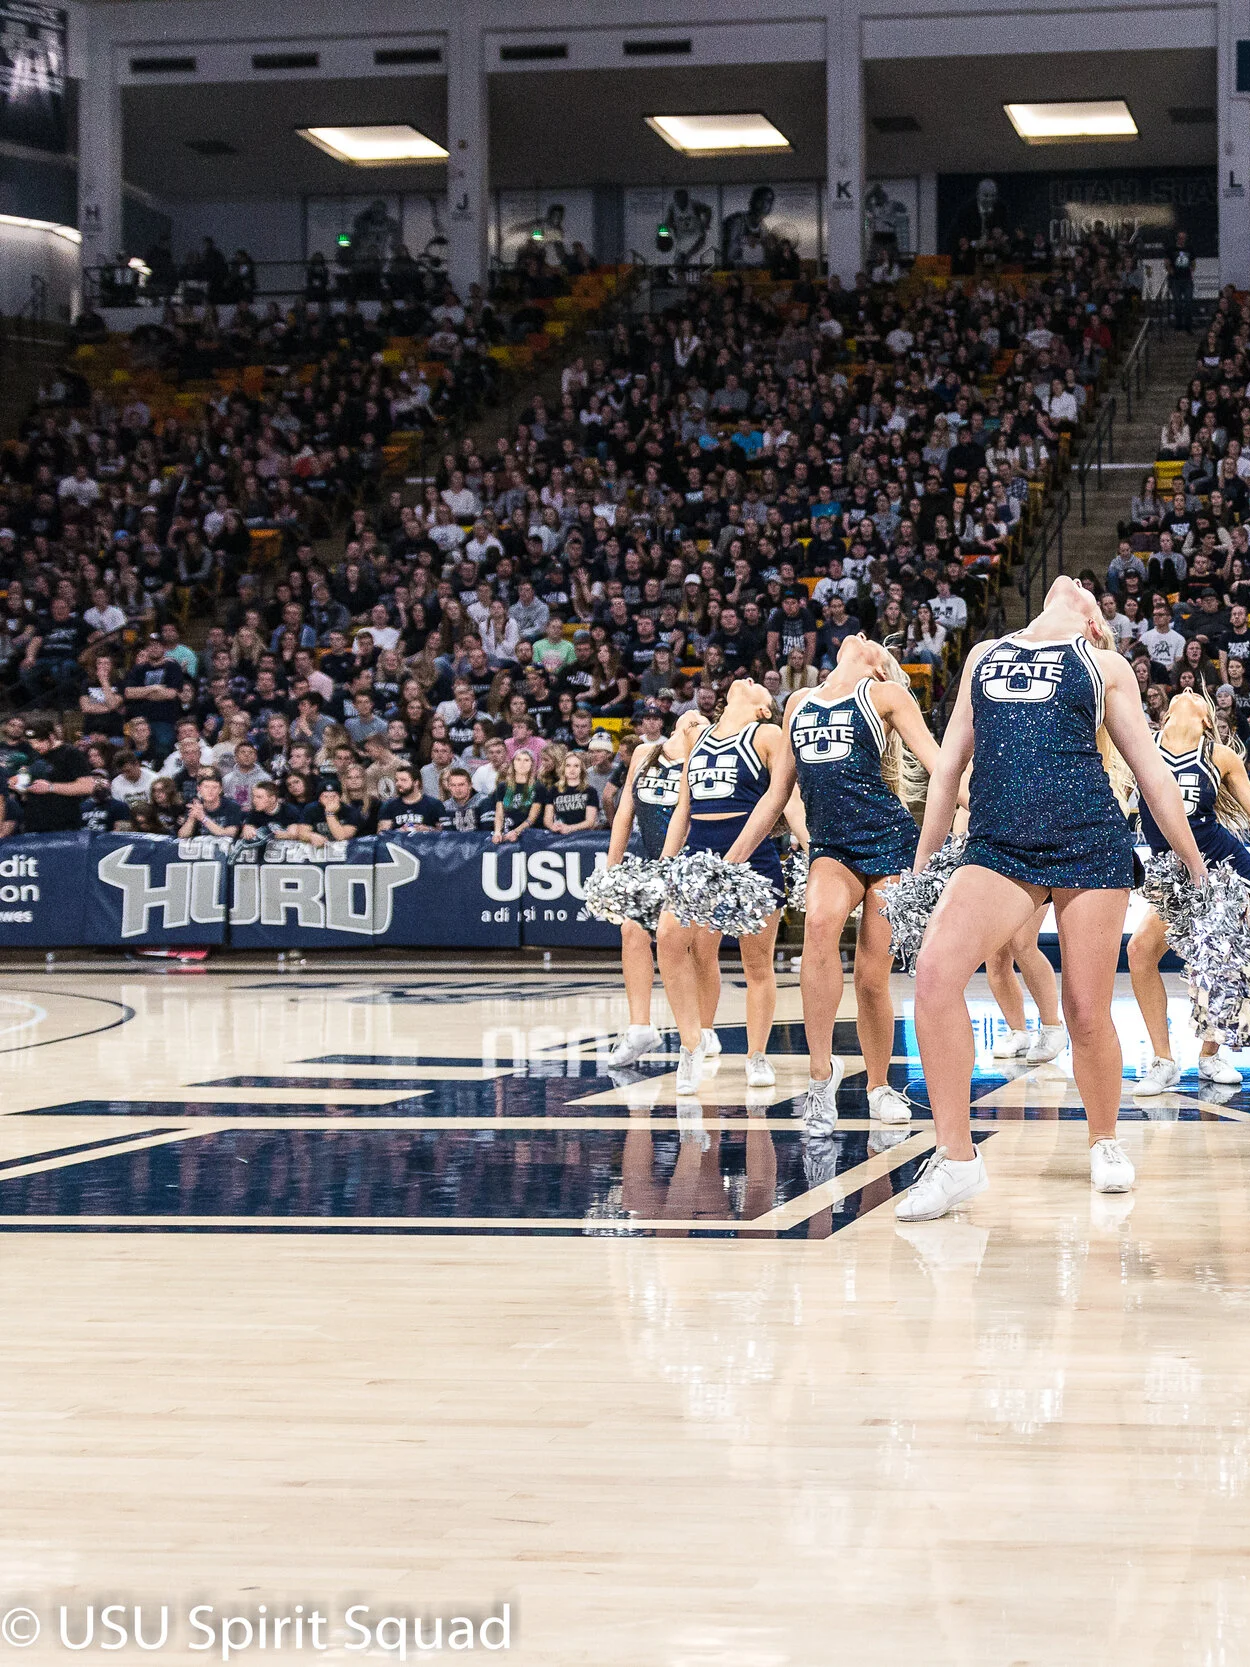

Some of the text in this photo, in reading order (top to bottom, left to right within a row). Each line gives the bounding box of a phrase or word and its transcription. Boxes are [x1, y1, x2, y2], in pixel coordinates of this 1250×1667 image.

[1229, 170, 1243, 187] L
[836, 181, 851, 198] K
[457, 193, 469, 210] J
[978, 661, 1065, 684] STATE
[792, 726, 855, 749] STATE
[688, 767, 739, 788] STATE
